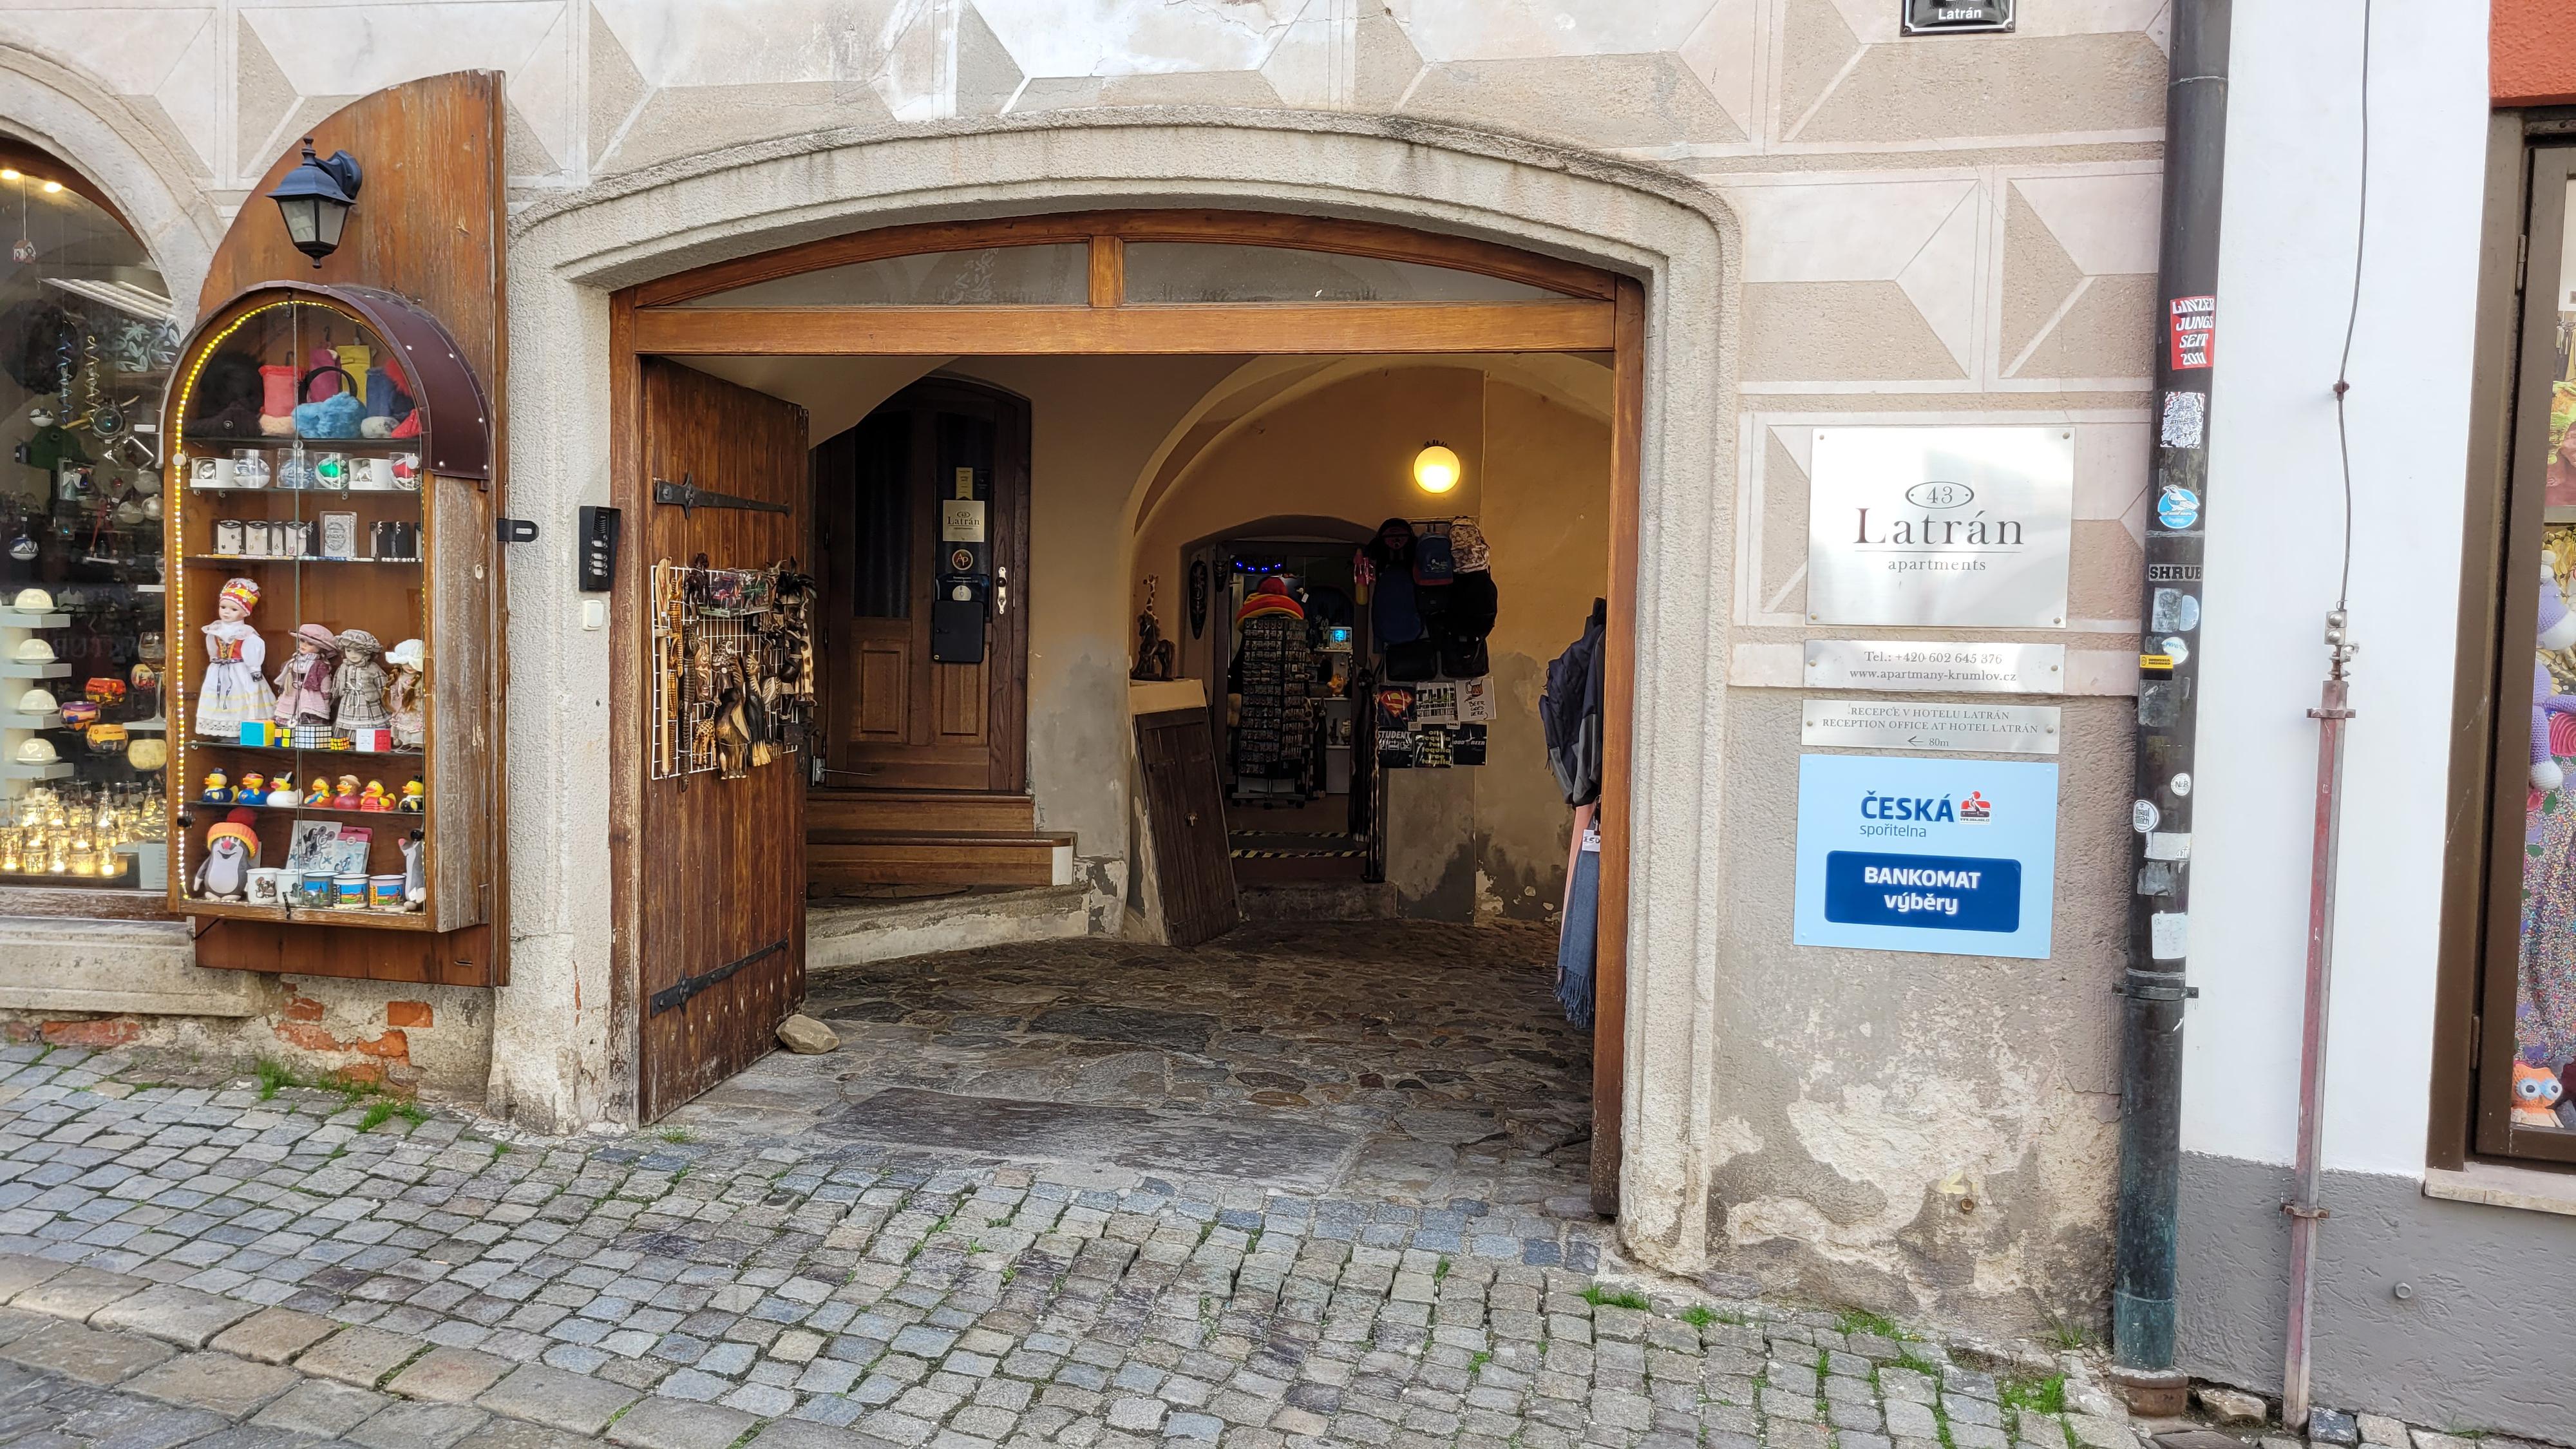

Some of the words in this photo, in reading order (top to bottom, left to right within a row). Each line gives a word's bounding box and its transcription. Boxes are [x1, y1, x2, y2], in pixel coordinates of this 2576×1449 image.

[1938, 6, 1982, 20] Latrán
[2172, 298, 2215, 314] LINZER
[2175, 316, 2213, 331] JUNGS
[2179, 333, 2209, 348] SEIT
[2180, 352, 2207, 365] 2011
[1926, 486, 1953, 504] 43
[947, 516, 980, 526] Latrán
[1852, 507, 2025, 545] Latrán
[1888, 559, 1986, 573] apartments
[1864, 651, 1891, 662] Tel.:
[1895, 652, 1925, 663] +420
[1929, 652, 1951, 663] 602
[1955, 652, 1976, 664] 645
[1981, 653, 2002, 665] 376
[1850, 670, 2016, 681] www.apartmany-krumlov.cz
[1851, 707, 1900, 716] RECEPCE
[1913, 710, 1960, 719] HOTELU
[1964, 710, 2009, 720] LATRÁN
[1823, 719, 1886, 728] RECEPTION
[1889, 721, 1929, 730] OFFICE
[1931, 722, 1947, 730] AT
[1949, 723, 1989, 732] HOTEL
[1991, 723, 2039, 734] LATRÁN
[1378, 730, 1412, 739] STUDENT
[1929, 738, 1949, 746] 80m
[1861, 790, 1955, 822] ČESKÁ
[1859, 824, 1927, 838] spořitelna
[1864, 867, 1982, 889] BANKOMAT
[1884, 893, 1958, 915] výběry
